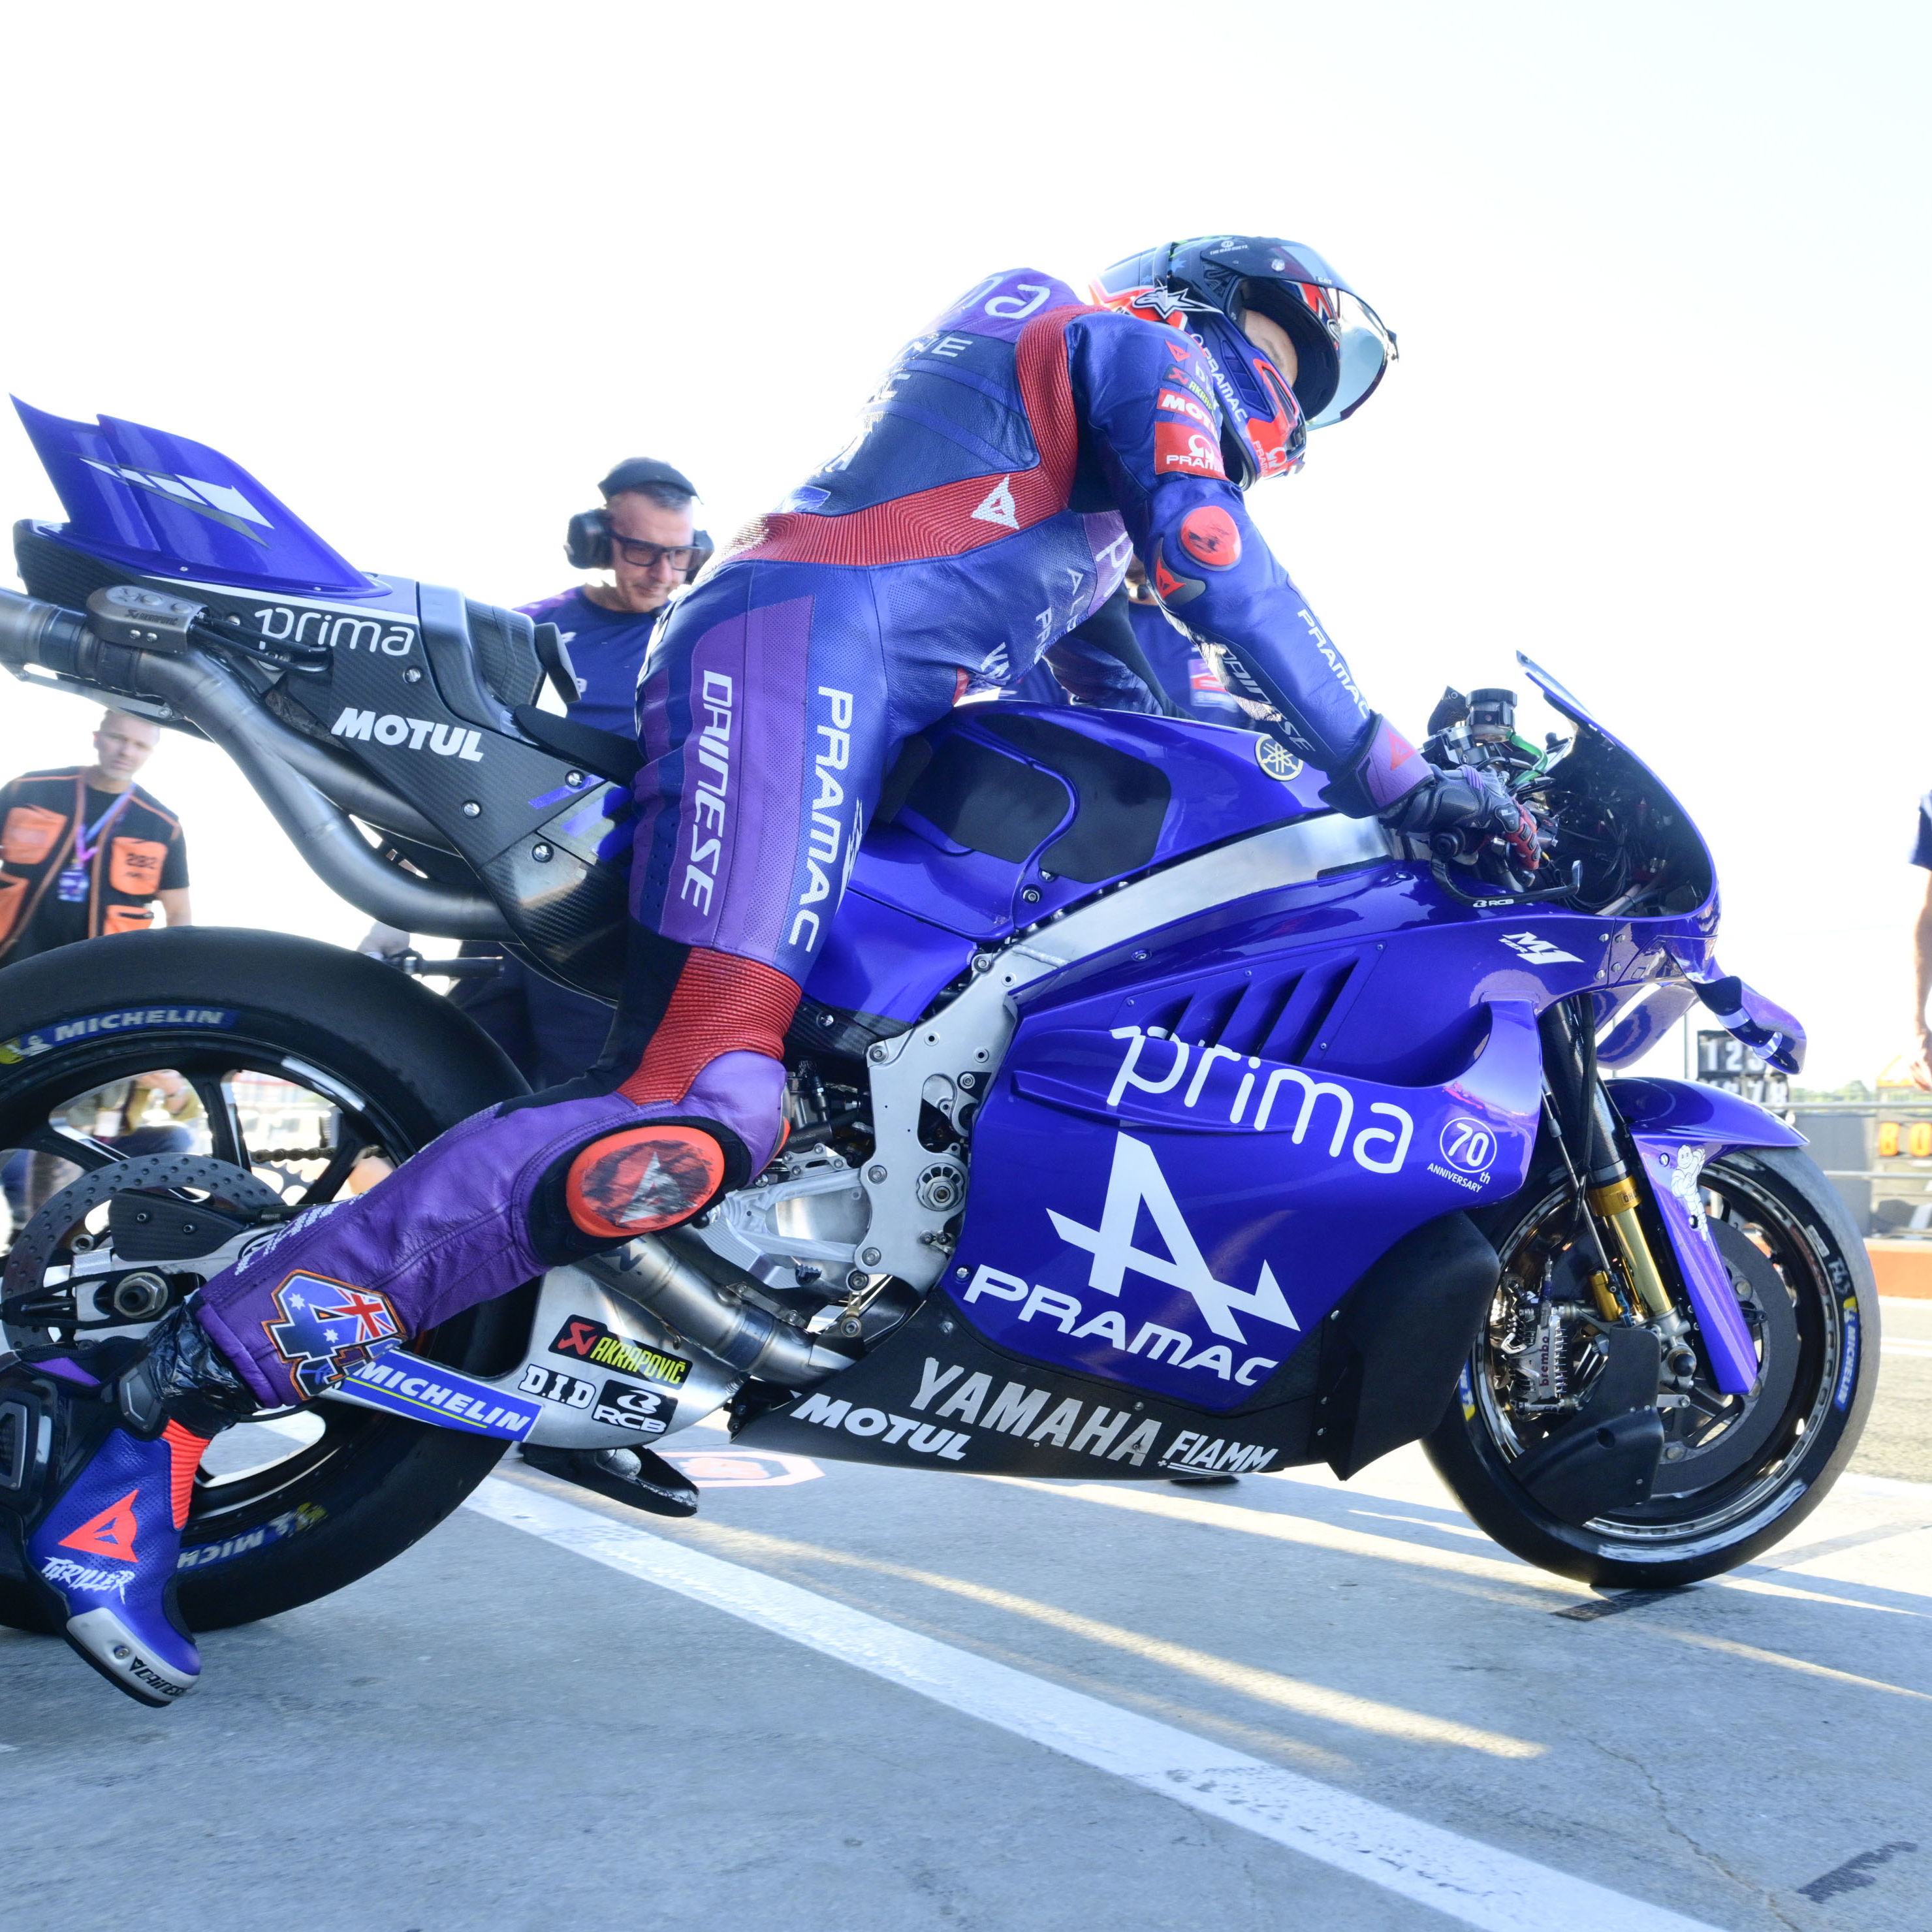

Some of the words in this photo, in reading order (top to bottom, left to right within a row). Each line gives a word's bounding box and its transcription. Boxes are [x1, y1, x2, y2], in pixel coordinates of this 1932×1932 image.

[1188, 381, 1214, 413] AKRA
[1203, 347, 1248, 422] PRAMAC
[1166, 454, 1223, 471] PRAM
[254, 607, 415, 656] prima
[1297, 609, 1370, 719] PRAMAC
[331, 706, 484, 762] MOTUL
[680, 670, 732, 916] DAINESE
[788, 686, 853, 952] PRAMAC
[54, 1009, 225, 1042] MICHELIN
[1106, 1026, 1414, 1174] prima
[1427, 1163, 1483, 1193] ANNIVERSARY
[1448, 1122, 1489, 1167] 70
[1480, 1171, 1491, 1184] th
[963, 1263, 1279, 1386] PRAMAC
[590, 1337, 686, 1385] AKRAPOVIČ
[1539, 1336, 1550, 1387] brembo
[1837, 1325, 1856, 1404] MICHELIN
[353, 1361, 531, 1432] MICHELIN
[593, 1404, 667, 1433] RCB
[910, 1357, 1162, 1467] YAMAHA
[789, 1393, 972, 1461] MOTUL
[1163, 1430, 1279, 1472] FIAMM
[177, 1530, 265, 1569] MICH
[41, 1557, 135, 1605] THRILLER
